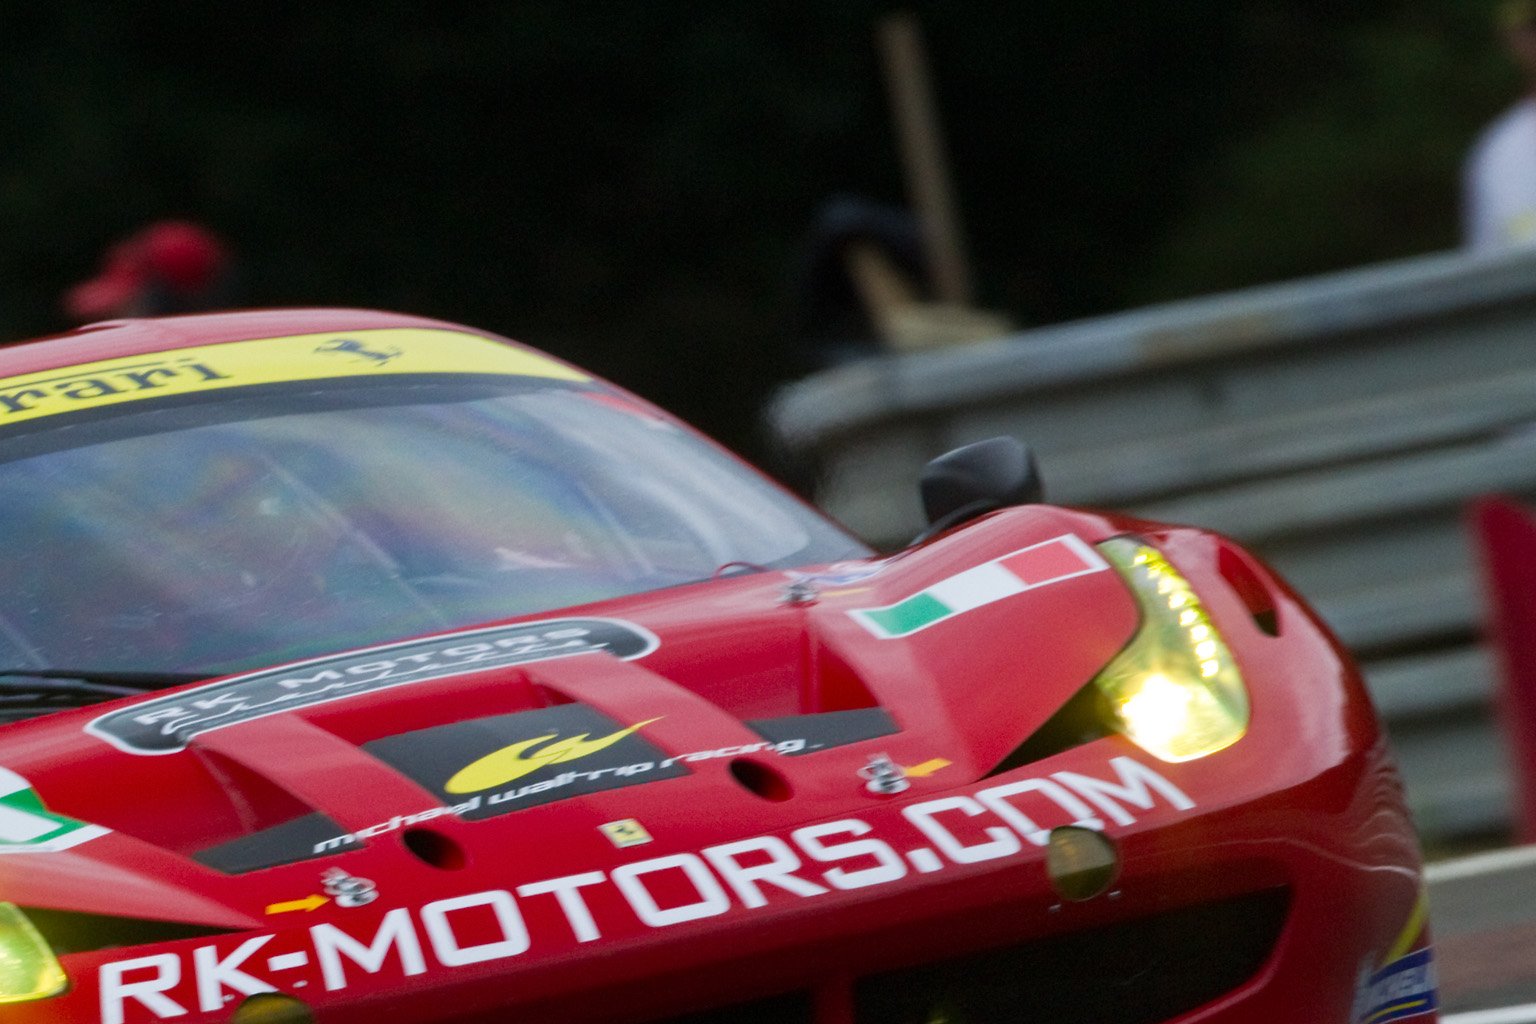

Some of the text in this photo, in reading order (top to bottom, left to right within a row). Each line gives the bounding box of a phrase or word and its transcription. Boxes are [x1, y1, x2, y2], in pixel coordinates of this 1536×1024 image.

[132, 627, 593, 727] RK MOTORS
[312, 738, 806, 855] michael waltrip racing
